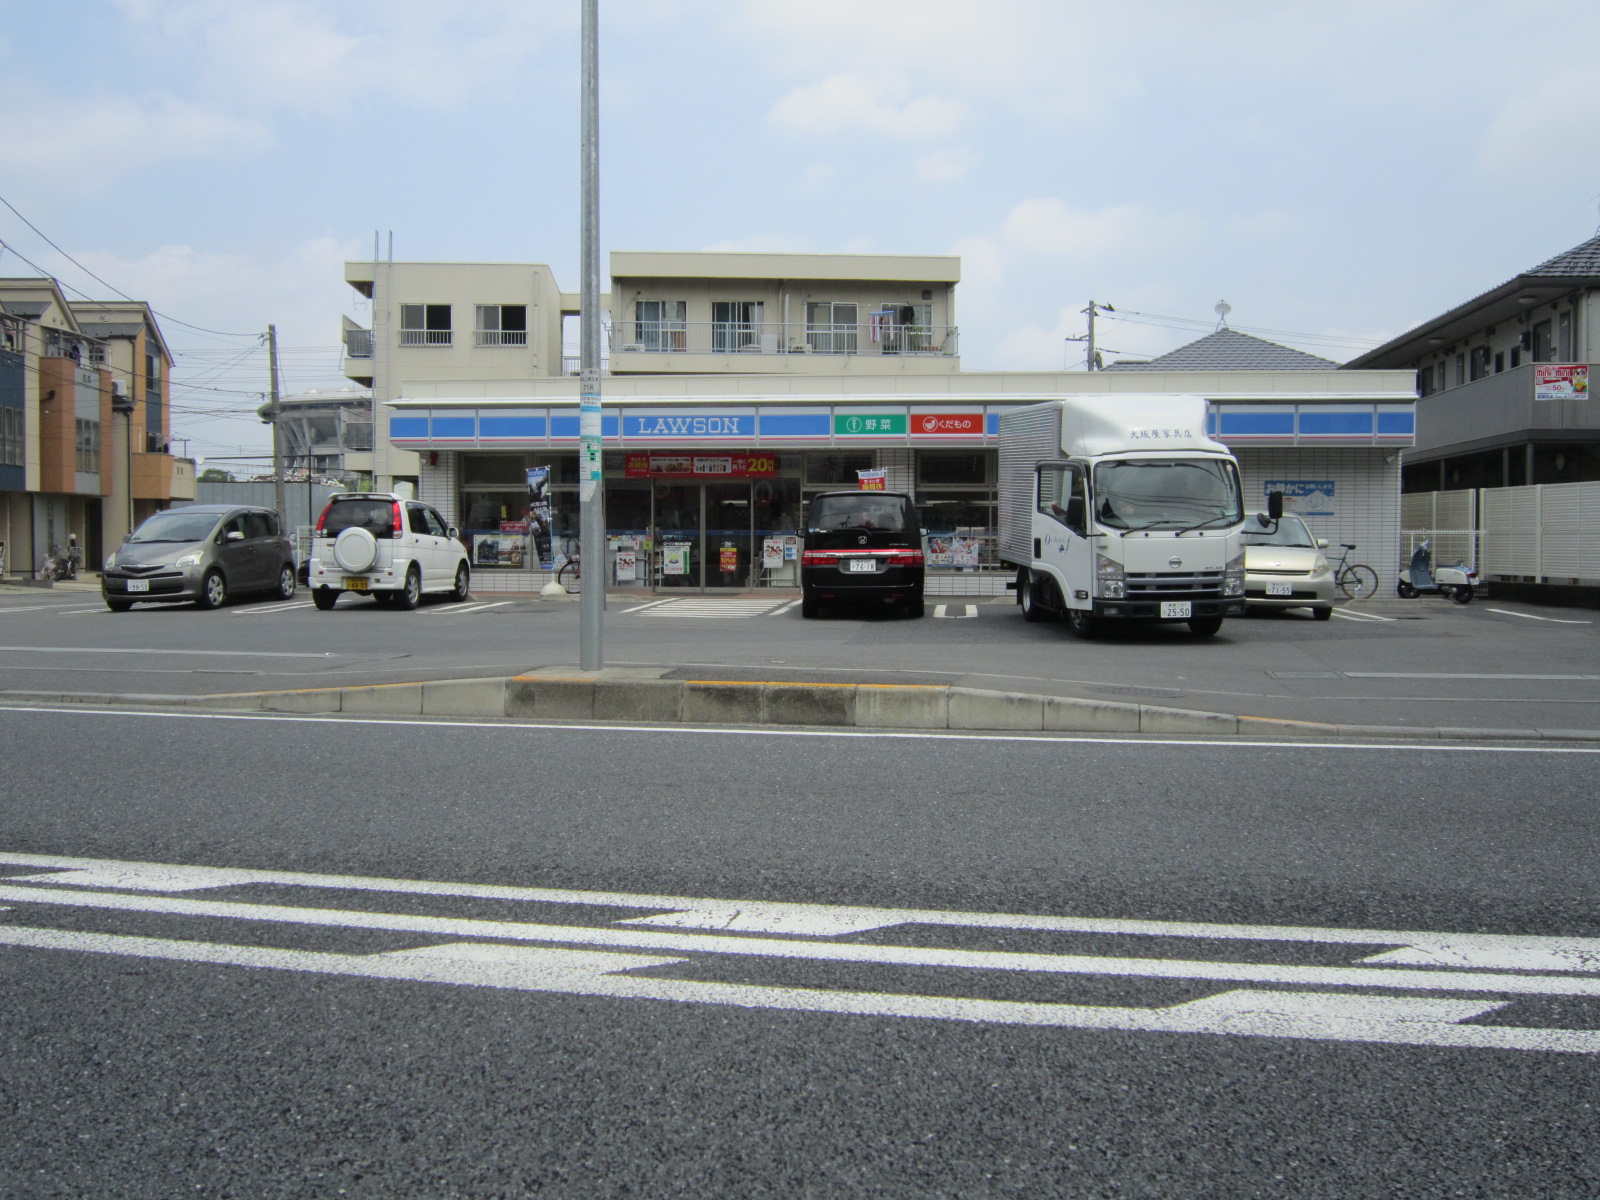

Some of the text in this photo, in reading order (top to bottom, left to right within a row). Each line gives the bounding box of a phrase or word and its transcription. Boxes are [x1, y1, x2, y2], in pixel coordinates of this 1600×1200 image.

[1556, 369, 1570, 377] mini
[638, 418, 740, 434] LAWSON
[865, 419, 892, 431] 野菜
[938, 419, 972, 429] くだもの
[747, 458, 768, 472] 20
[855, 563, 875, 571] 76-18
[1167, 608, 1190, 617] 25-50
